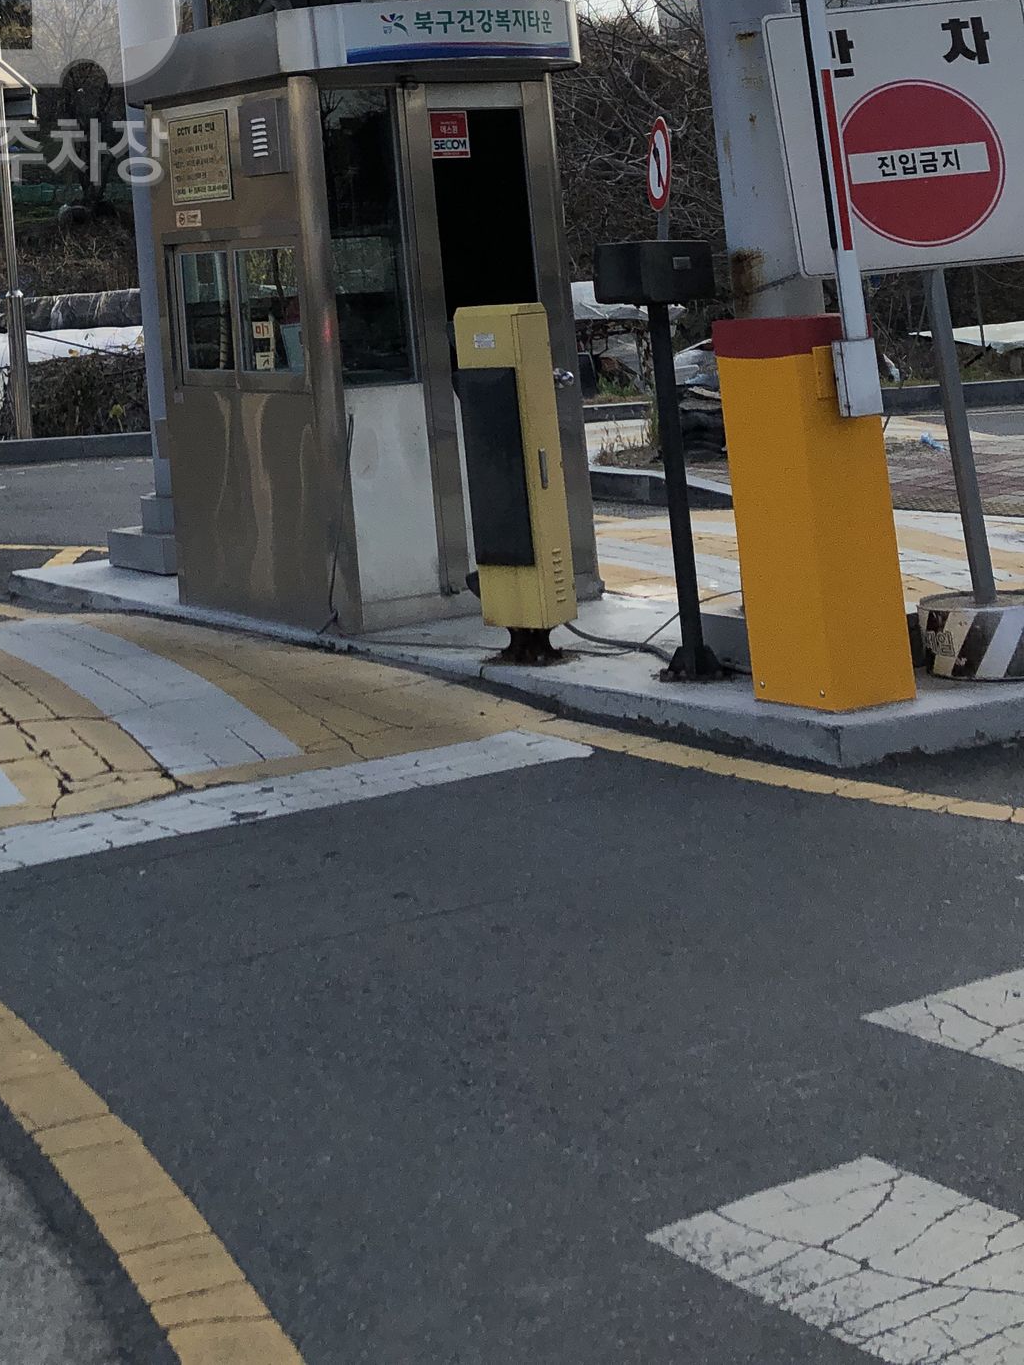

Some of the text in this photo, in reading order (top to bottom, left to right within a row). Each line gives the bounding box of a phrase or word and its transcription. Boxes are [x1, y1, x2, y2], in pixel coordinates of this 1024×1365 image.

[414, 10, 553, 35] 북구건강복지타운
[433, 138, 467, 150] SECOM
[877, 148, 962, 177] 진입금지
